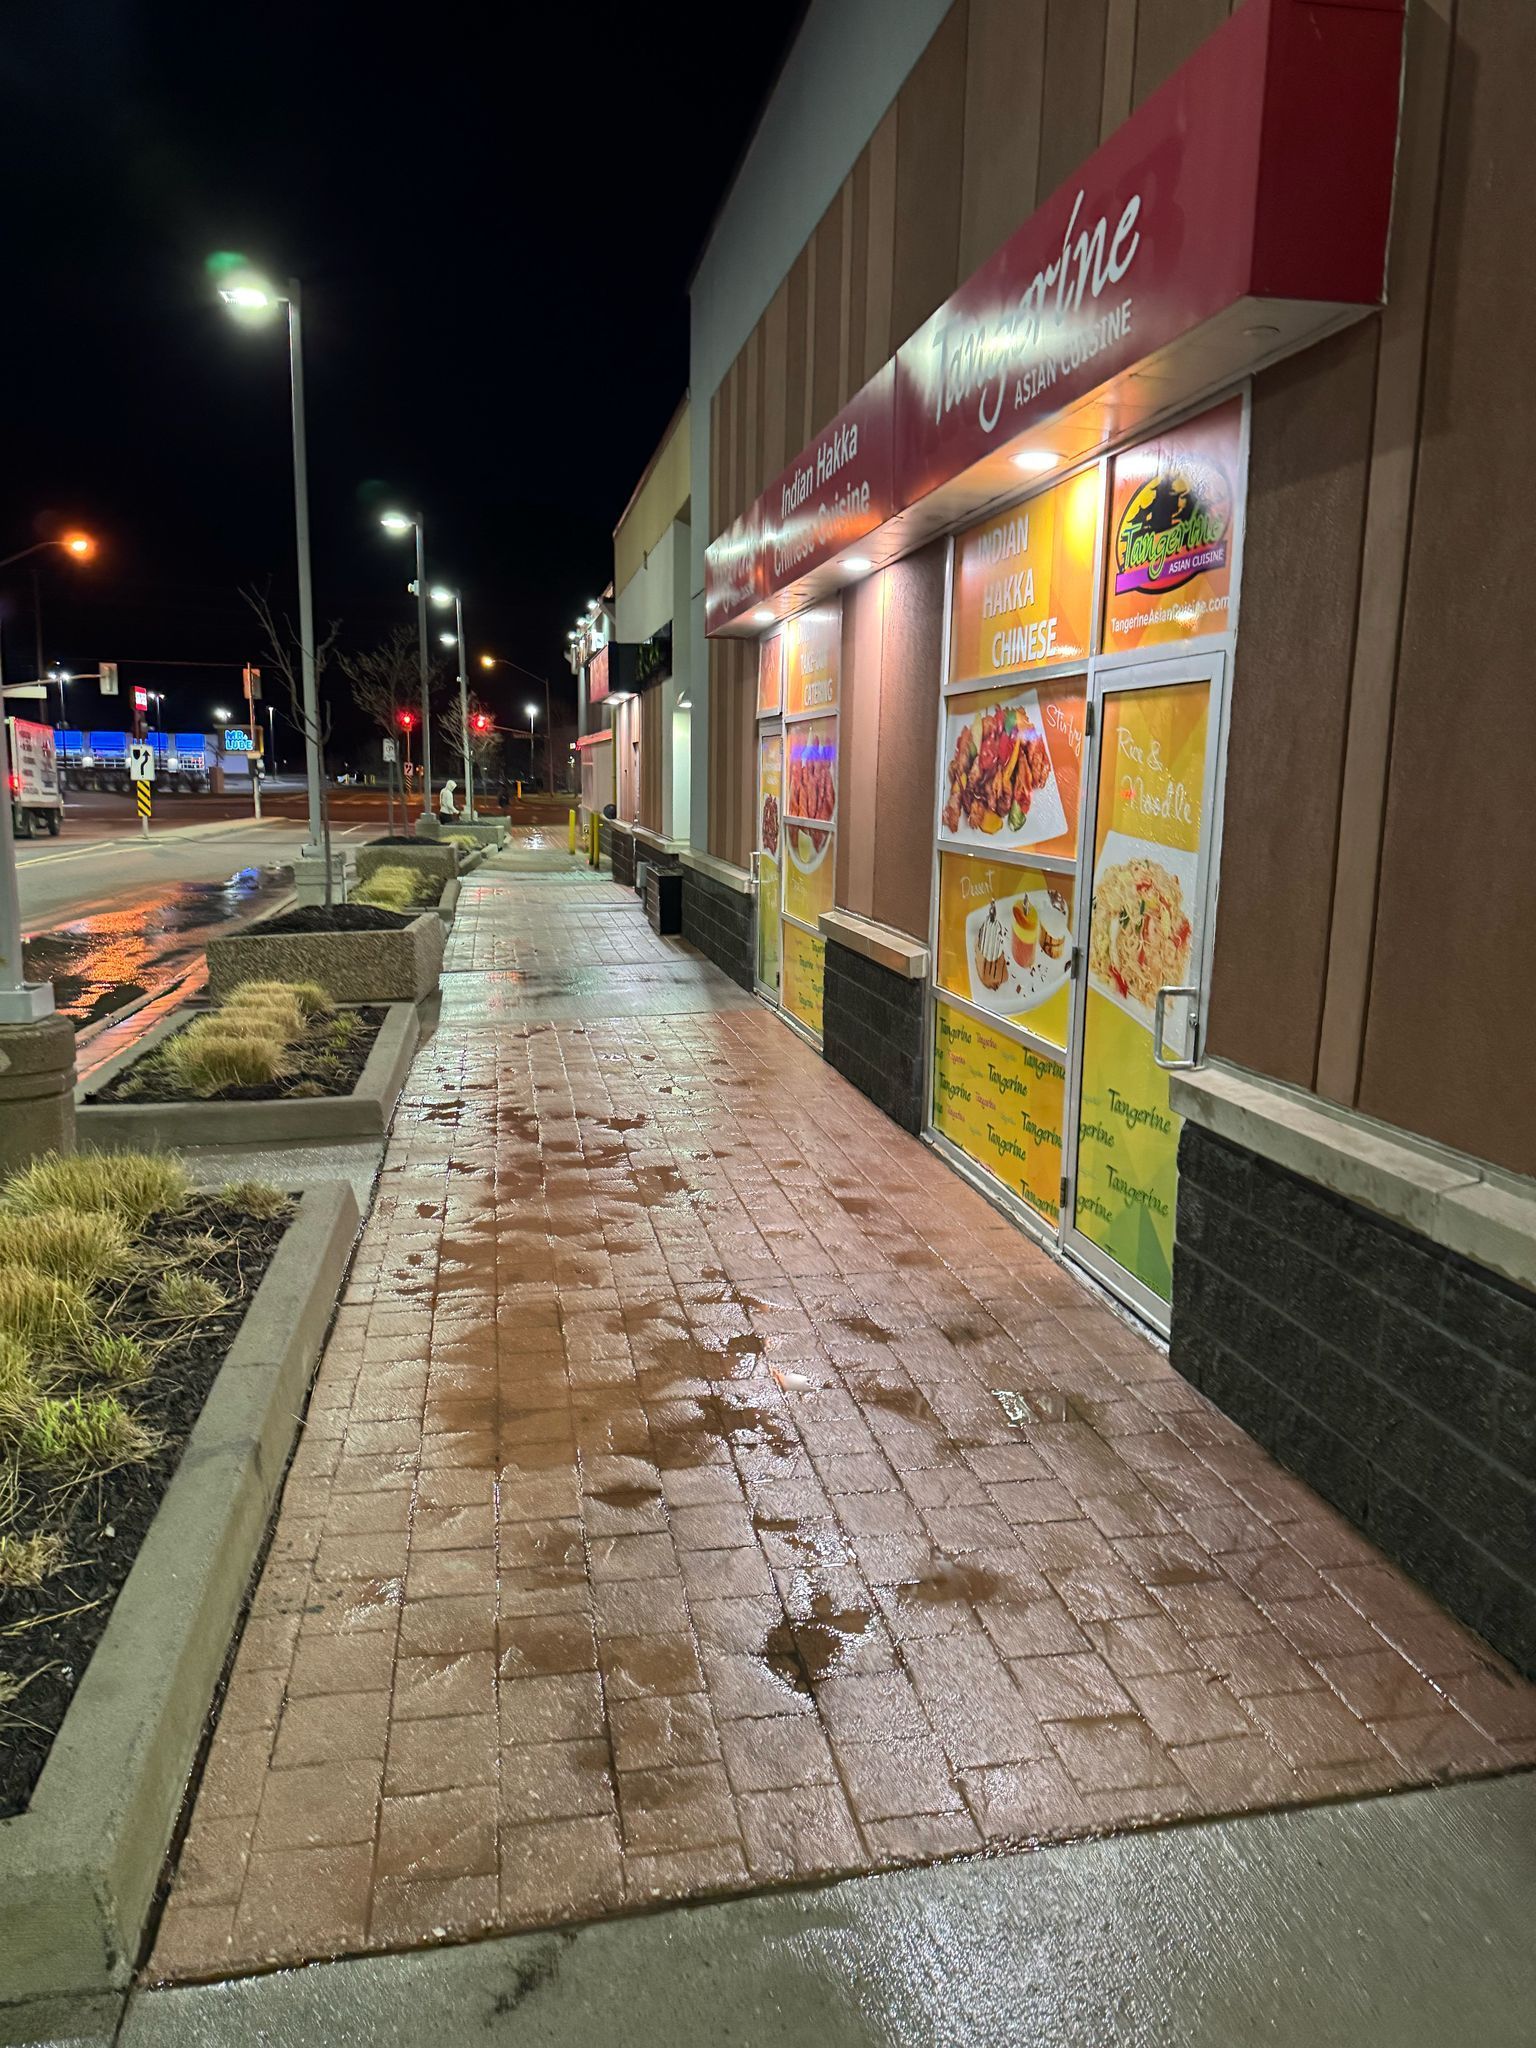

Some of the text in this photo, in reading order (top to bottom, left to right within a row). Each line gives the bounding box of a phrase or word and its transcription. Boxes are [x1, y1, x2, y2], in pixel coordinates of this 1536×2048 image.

[932, 190, 1141, 432] Tangerine
[1014, 298, 1133, 410] ASIAN CUISINE
[781, 423, 858, 520] Indian Hakka
[817, 480, 870, 545] Cuisine
[978, 512, 1030, 565] INDIAN
[1120, 500, 1224, 580] Tangerine
[1168, 548, 1224, 575] ASIAN CUISINE
[983, 567, 1035, 620] HAKKA
[1111, 595, 1230, 635] TangerineAsianCuisine.com
[991, 616, 1057, 669] CHINESE
[225, 739, 253, 750] LUBE
[1067, 714, 1082, 757] fry
[1116, 727, 1163, 772] Rice &
[1121, 775, 1192, 824] Noodle
[960, 869, 995, 899] Dessert
[939, 1017, 972, 1044] Tangerine
[939, 1072, 972, 1103] Tangerine
[987, 1063, 1028, 1097] Tangerine
[1107, 1088, 1172, 1134] Tangerine
[986, 1123, 1026, 1161] Tangerine
[1080, 1122, 1115, 1148] gerine
[1077, 1195, 1113, 1224] gerine
[1105, 1164, 1169, 1218] Tangerine
